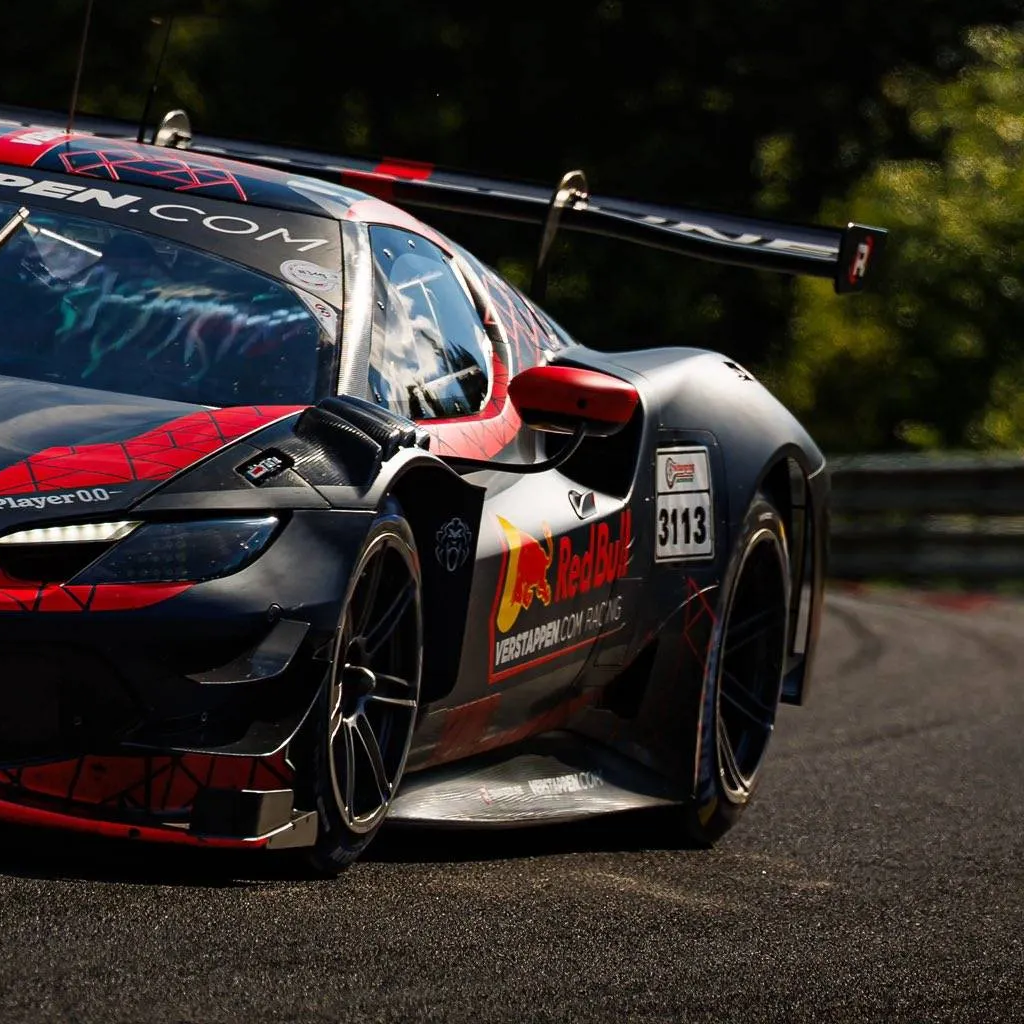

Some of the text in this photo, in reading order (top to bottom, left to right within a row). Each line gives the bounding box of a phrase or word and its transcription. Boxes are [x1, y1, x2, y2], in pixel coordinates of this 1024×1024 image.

[658, 506, 707, 547] 3113
[553, 522, 596, 603] Red
[494, 611, 585, 666] VERSTAPPEN.COM
